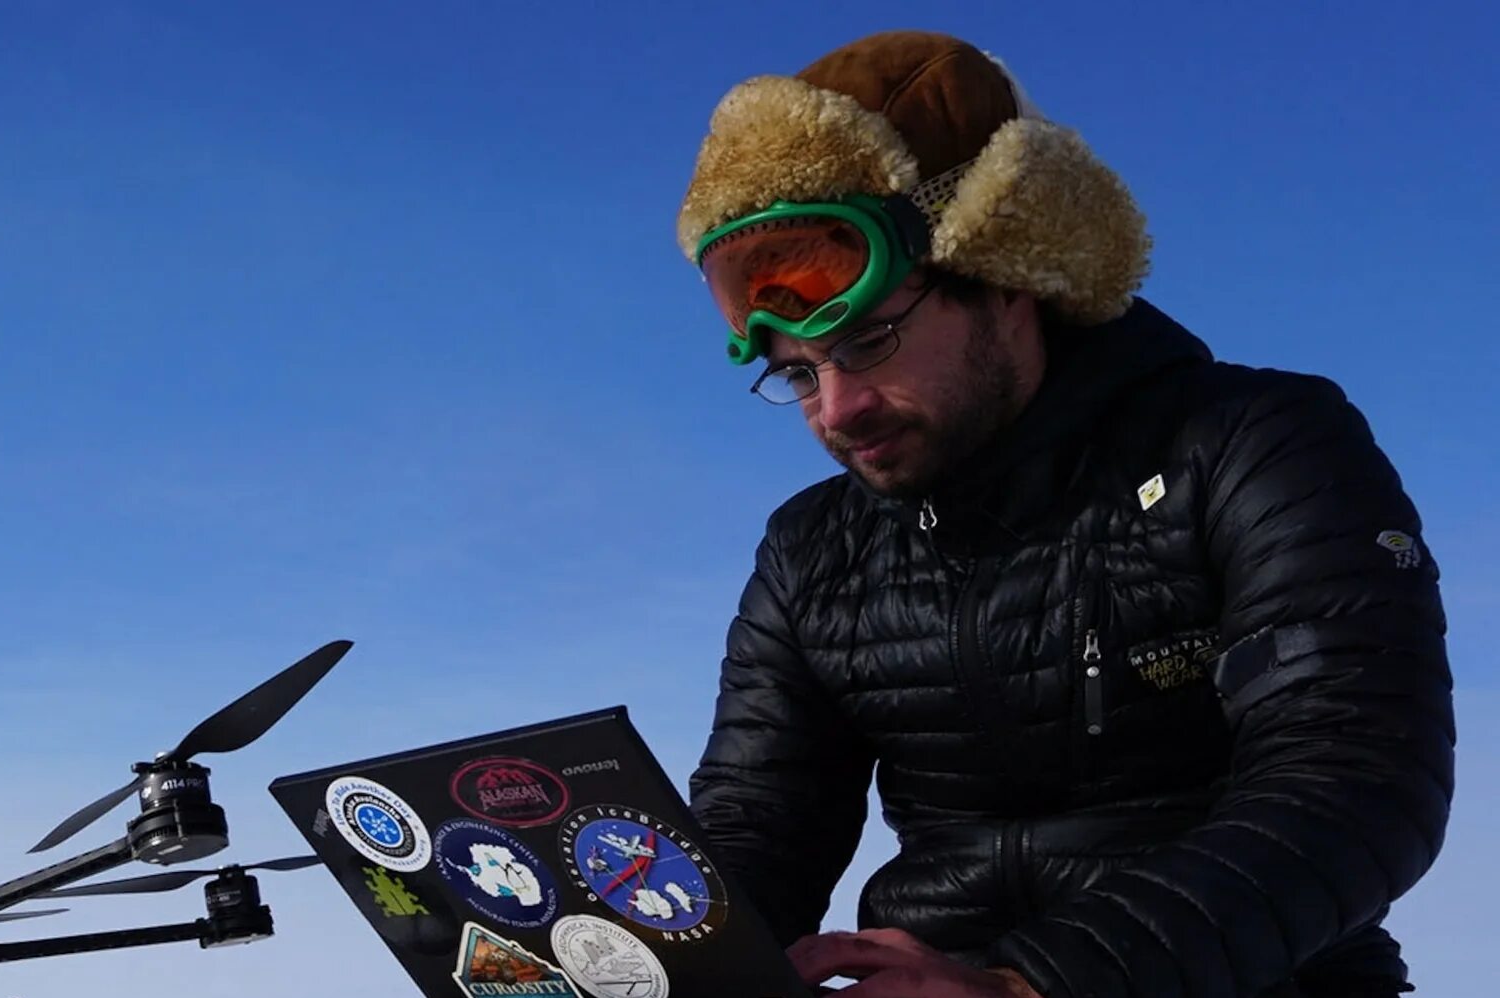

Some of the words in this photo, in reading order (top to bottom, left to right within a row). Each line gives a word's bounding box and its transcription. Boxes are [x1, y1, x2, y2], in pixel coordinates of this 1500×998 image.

[1139, 653, 1187, 681] HARD
[1154, 663, 1204, 691] WEAR
[562, 758, 621, 777] lenovo
[478, 783, 552, 812] ALASKAN
[450, 821, 507, 841] ENGINEERING
[592, 922, 639, 950] INSTITUTE
[662, 923, 714, 943] NASA
[469, 980, 569, 996] CURIOSITY
